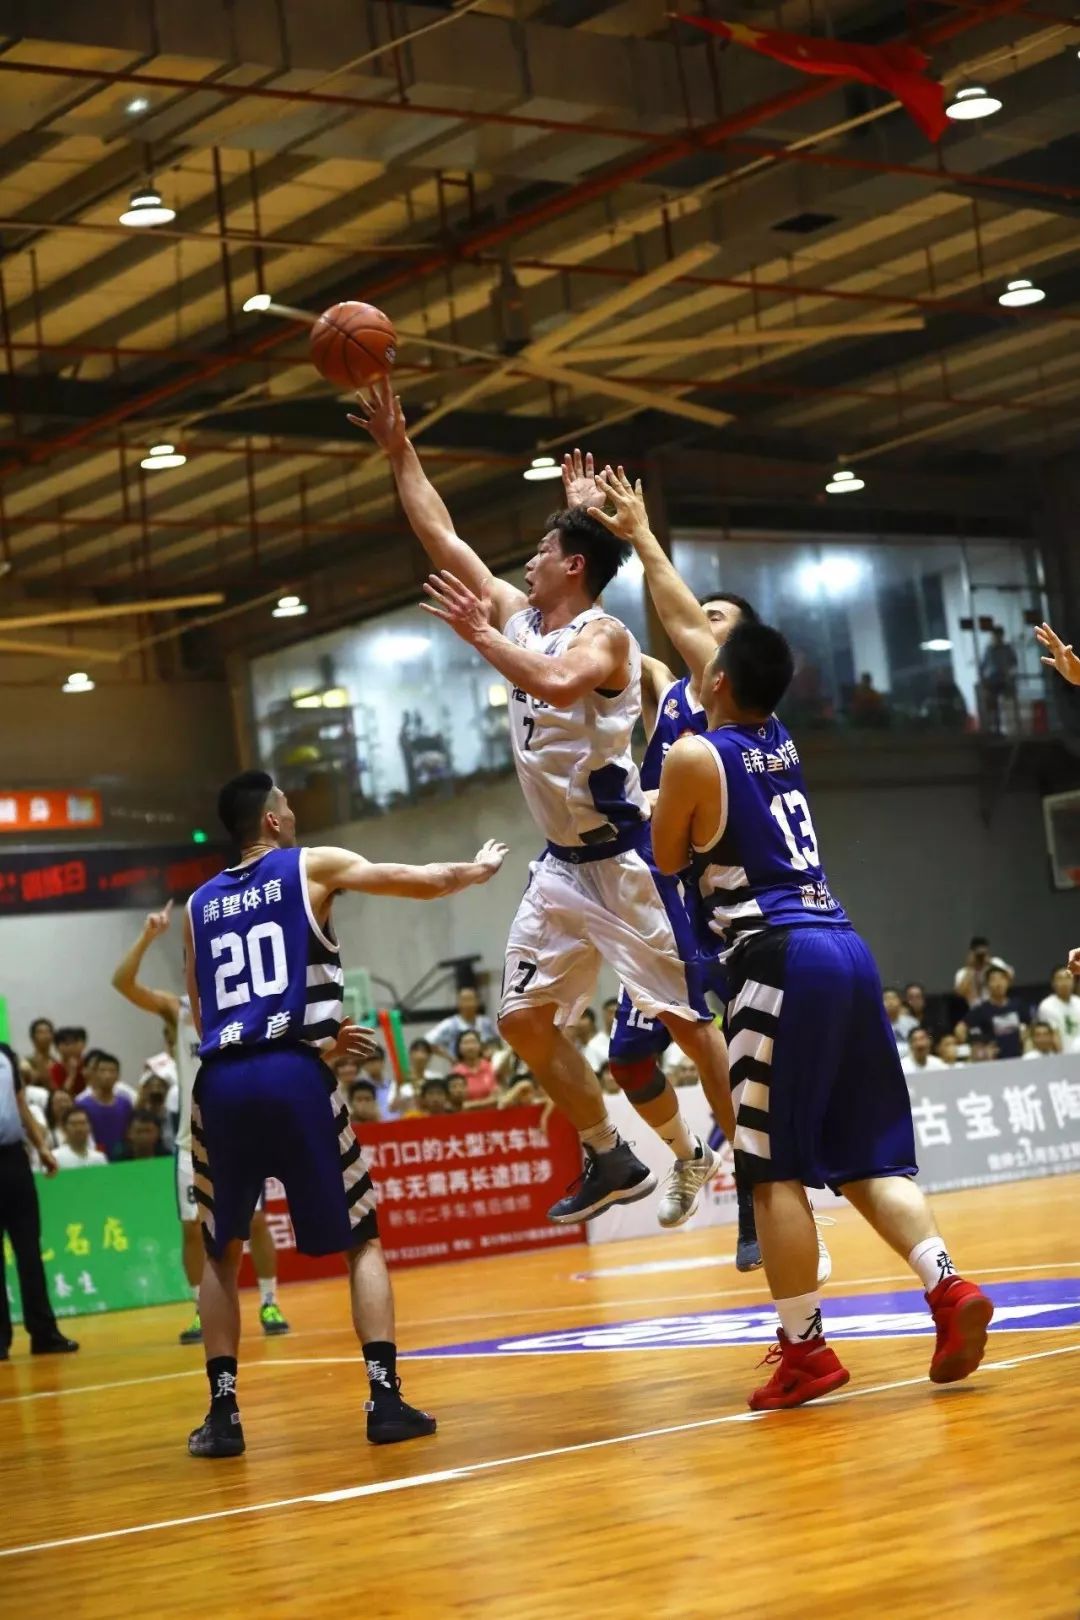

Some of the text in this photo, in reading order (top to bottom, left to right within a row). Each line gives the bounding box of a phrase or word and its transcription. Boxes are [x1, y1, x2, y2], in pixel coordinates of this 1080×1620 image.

[523, 716, 535, 750] 7
[770, 789, 820, 871] 13
[210, 921, 289, 1010] 20
[514, 961, 537, 993] 7
